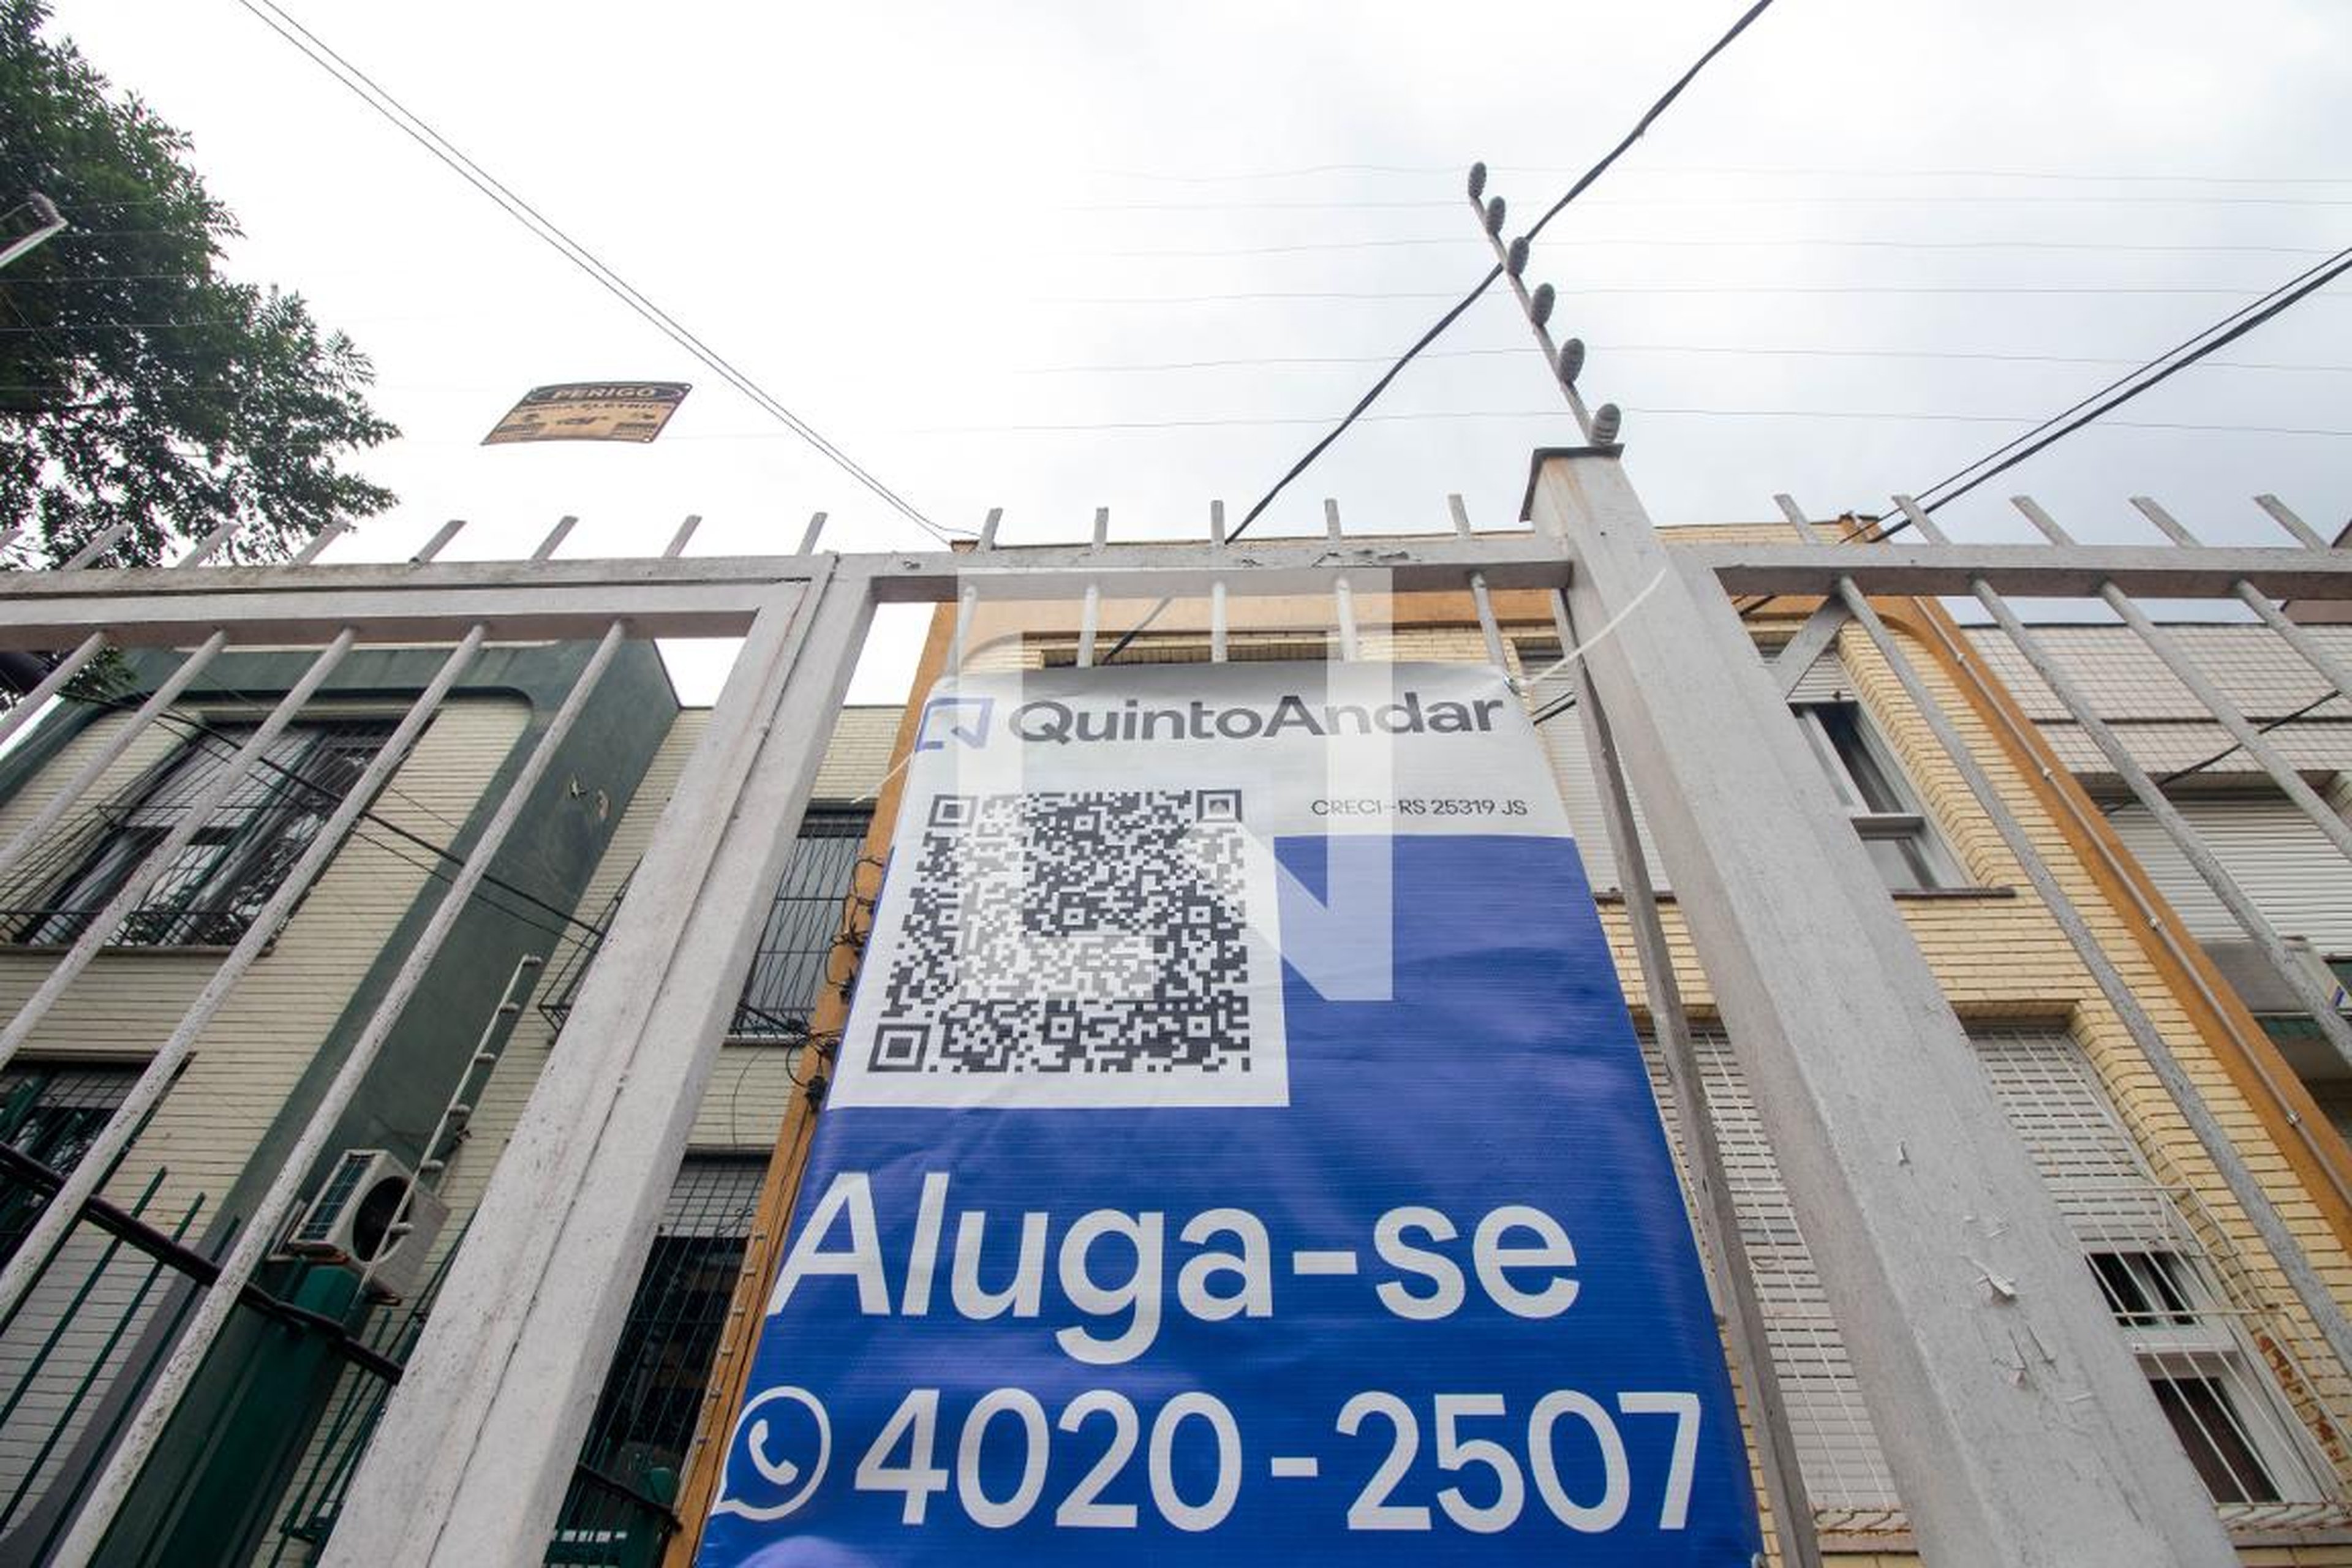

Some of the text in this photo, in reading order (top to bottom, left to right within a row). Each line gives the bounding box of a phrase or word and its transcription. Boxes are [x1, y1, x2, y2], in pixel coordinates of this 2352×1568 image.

[552, 385, 655, 399] PERIGO
[1008, 692, 1504, 746] QuintoAndar
[1430, 799, 1496, 816] 25319
[1501, 799, 1528, 816] JS
[766, 1172, 1579, 1365] Aluga-se
